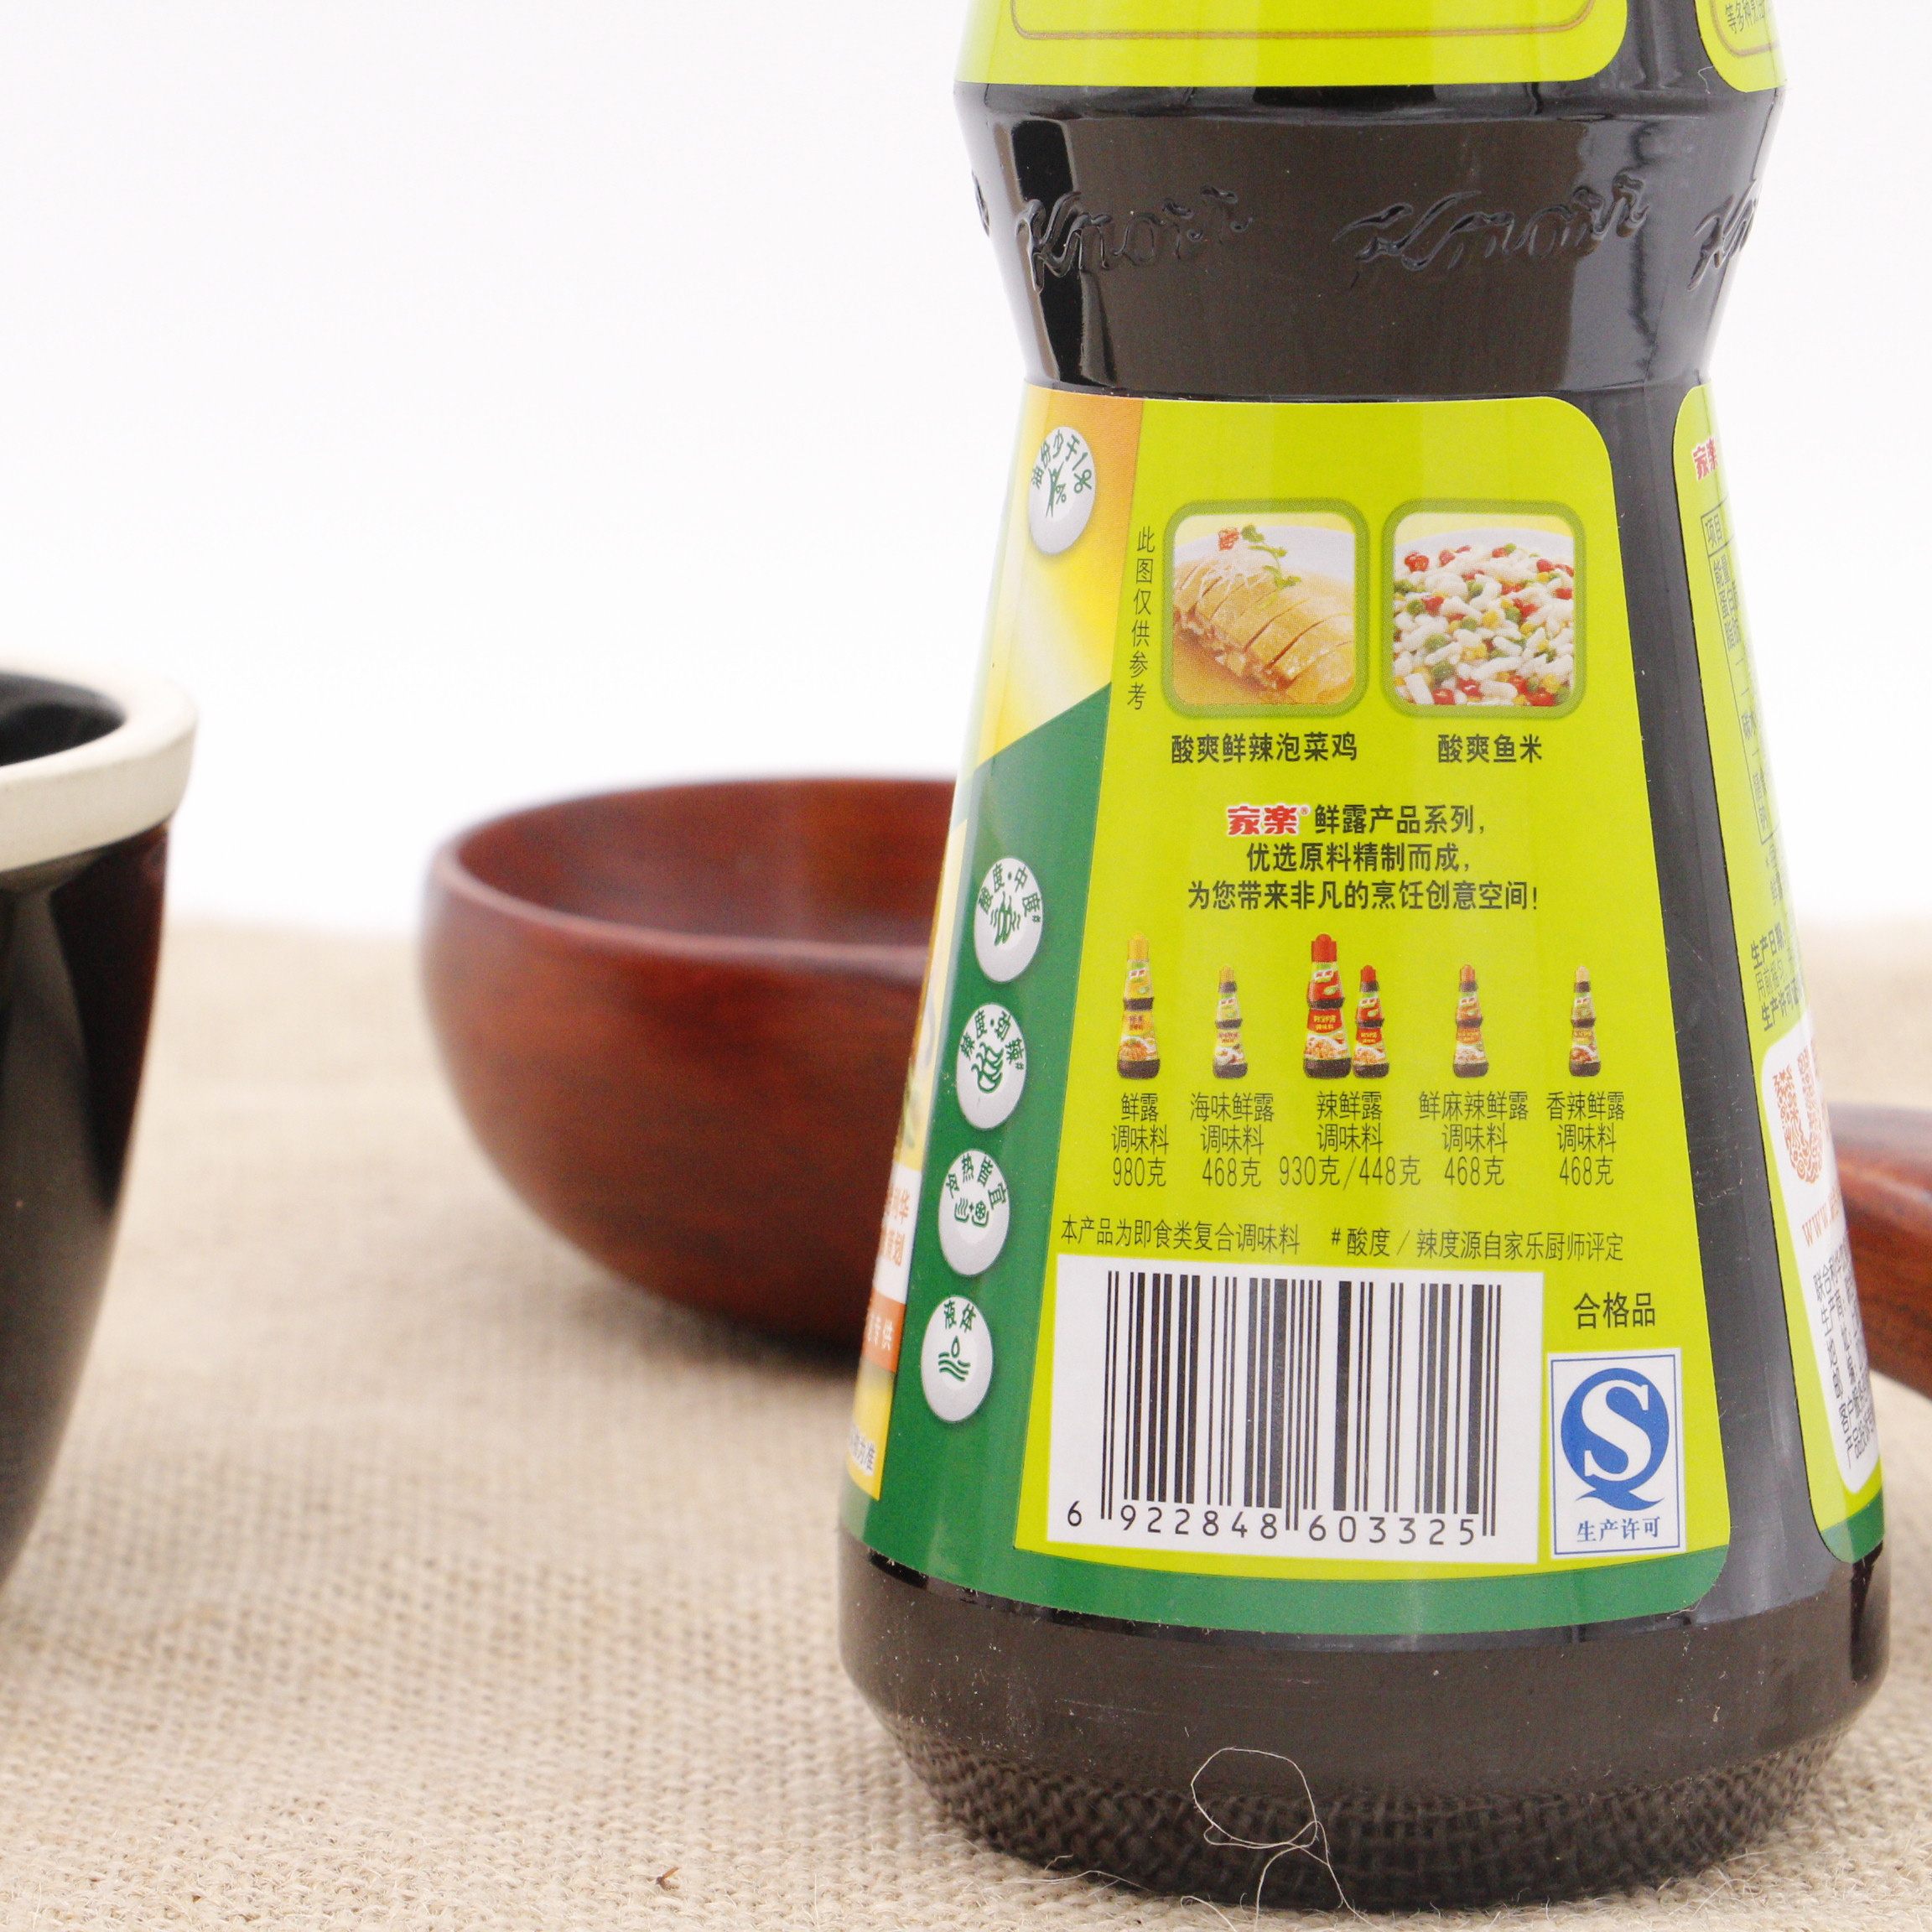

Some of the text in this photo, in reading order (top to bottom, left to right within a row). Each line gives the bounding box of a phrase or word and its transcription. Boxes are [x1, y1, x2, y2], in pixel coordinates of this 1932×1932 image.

[1127, 526, 1156, 711] 此图仅供参考
[1171, 732, 1358, 764] 酸爽鲜辣泡菜鸡
[1437, 733, 1543, 764] 酸爽鱼米
[1120, 1093, 1160, 1122] 鲜露
[1190, 1092, 1275, 1122] 海味鲜露
[1317, 1090, 1384, 1121] 辣鲜露
[1418, 1090, 1530, 1121] 鲜麻辣鲜露
[1546, 1090, 1626, 1121] 香辣鲜露
[1111, 1124, 1170, 1156] 调味料
[1200, 1124, 1265, 1156] 调味料
[1317, 1123, 1384, 1154] 调味料
[1441, 1122, 1509, 1154] 调味料
[1556, 1123, 1617, 1154] 调味料
[1112, 1156, 1167, 1187] 980克
[1202, 1156, 1261, 1187] 468克
[1444, 1155, 1505, 1187] 468克
[1559, 1155, 1614, 1187] 468克
[1061, 1213, 1301, 1256] 本产品为即食类复合调味料
[943, 1299, 977, 1333] 液体
[1572, 1291, 1656, 1330] 合格品
[1576, 1515, 1661, 1543] 生产许可
